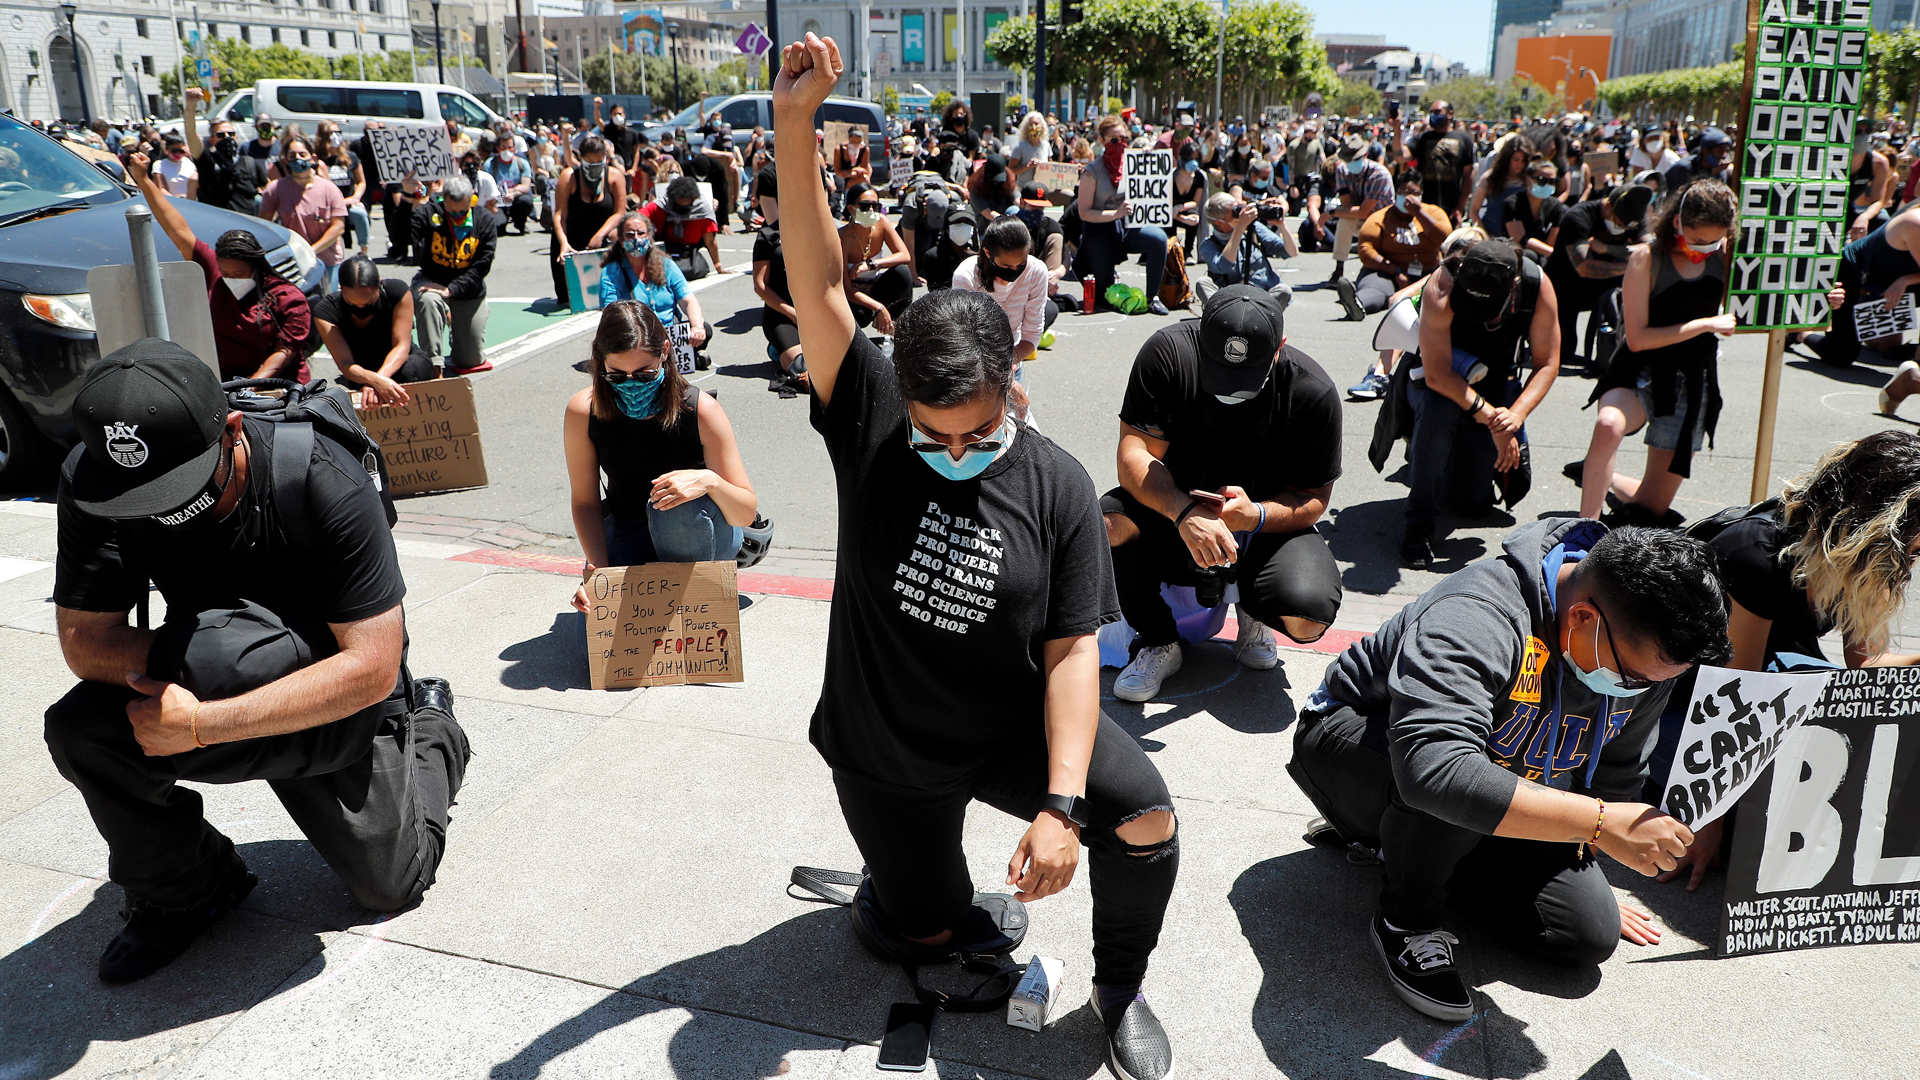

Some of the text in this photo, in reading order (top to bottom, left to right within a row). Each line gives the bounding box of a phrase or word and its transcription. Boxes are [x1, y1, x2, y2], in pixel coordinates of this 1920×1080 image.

[1762, 0, 1871, 27] ACTS
[1759, 27, 1866, 65] EASE
[1755, 66, 1861, 104] PAIN
[371, 128, 445, 142] FOLLOW
[1750, 105, 1855, 143] OPEN
[373, 138, 441, 159] BLACK
[1748, 143, 1850, 180] YOUR
[378, 153, 454, 181] LEADERSHIP
[1127, 153, 1171, 175] DEFEND
[1050, 179, 1075, 189] PEACE
[1129, 178, 1167, 199] BLACK
[1742, 181, 1847, 217] EYES
[1128, 203, 1170, 225] VOICES
[1741, 219, 1843, 254] THEN
[1736, 256, 1838, 291] YOUR
[1729, 292, 1831, 326] MIND
[1855, 306, 1877, 339] BLACK
[414, 392, 452, 415] the
[104, 425, 139, 440] BAY
[156, 491, 216, 526] BREATHE
[919, 516, 1004, 559] PRO BROWN
[954, 516, 1002, 541] BLACK
[916, 533, 999, 575] PRO QUEER
[910, 549, 995, 591] PRO TRANS
[594, 573, 680, 600] OFFICER-
[896, 562, 997, 610] PRO SCIENCE
[664, 599, 709, 616] SERVE
[893, 580, 987, 622] PRO CHOICE
[597, 618, 719, 639] THE POLITICAL POWER
[900, 601, 969, 634] PRO HOE
[603, 628, 728, 659] OR THE PEOPLE?
[614, 650, 729, 679] THE COMMUNITY!
[1827, 667, 1920, 687] FLOYD. BREO
[1515, 673, 1541, 694] NOW
[1831, 686, 1890, 701] MARTIN.
[1827, 700, 1887, 719] CASTILE.
[1683, 687, 1792, 775] CAN'T
[1757, 724, 1920, 893] BL
[1727, 898, 1780, 917] WALTER
[1884, 889, 1920, 907] JEFF
[1729, 915, 1768, 932] INDIA
[1771, 914, 1784, 929] M
[1787, 911, 1835, 929] BEATY.
[1834, 907, 1895, 925] TYRONE
[1726, 930, 1773, 954] BRIAN
[1777, 926, 1836, 949] PICKETT.
[1841, 925, 1895, 943] ABDUL
